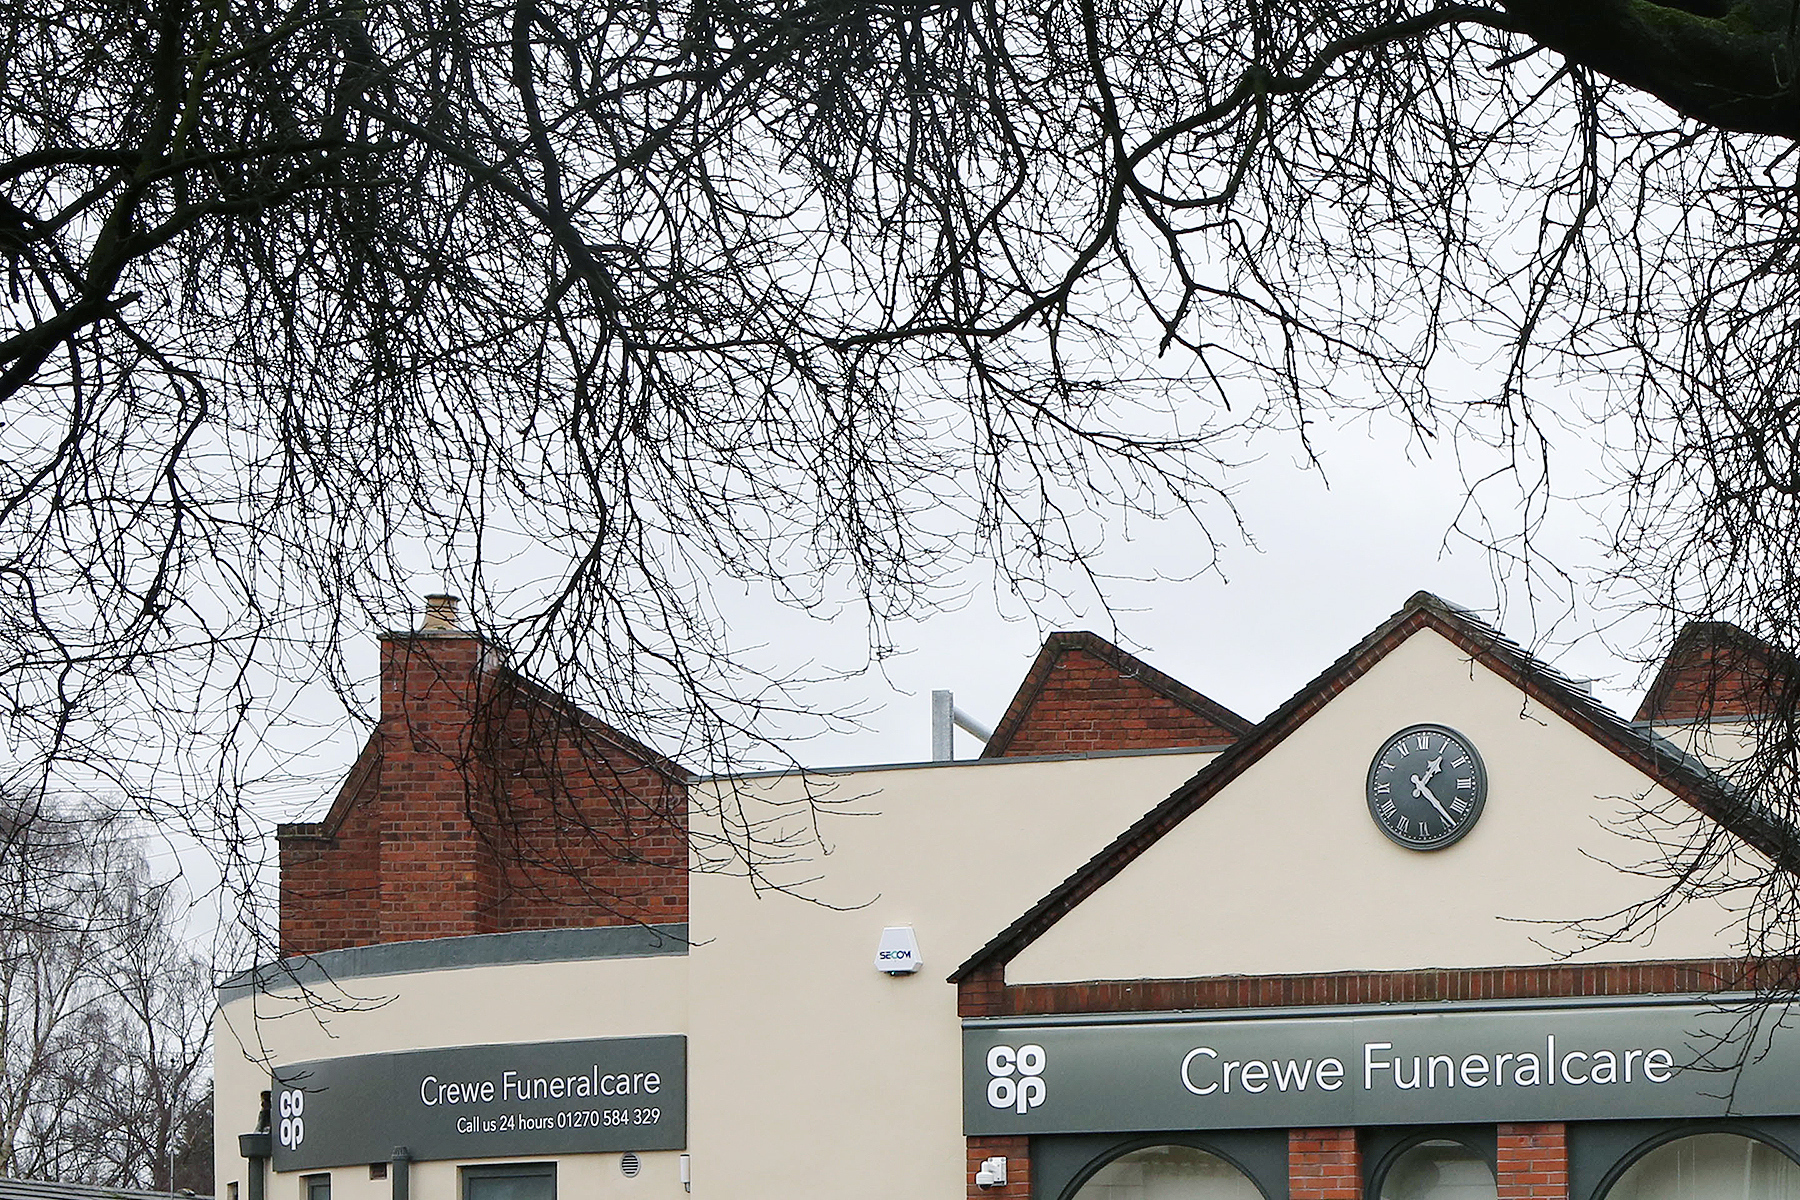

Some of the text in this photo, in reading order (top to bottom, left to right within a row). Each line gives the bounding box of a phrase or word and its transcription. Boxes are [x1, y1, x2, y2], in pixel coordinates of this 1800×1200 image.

[880, 950, 912, 960] SECOM
[1180, 1033, 1675, 1095] Crewe Funeralcare
[420, 1064, 662, 1106] Crewe Funeralcare
[456, 1107, 661, 1134] Call us 24 hours 01270 584 329
